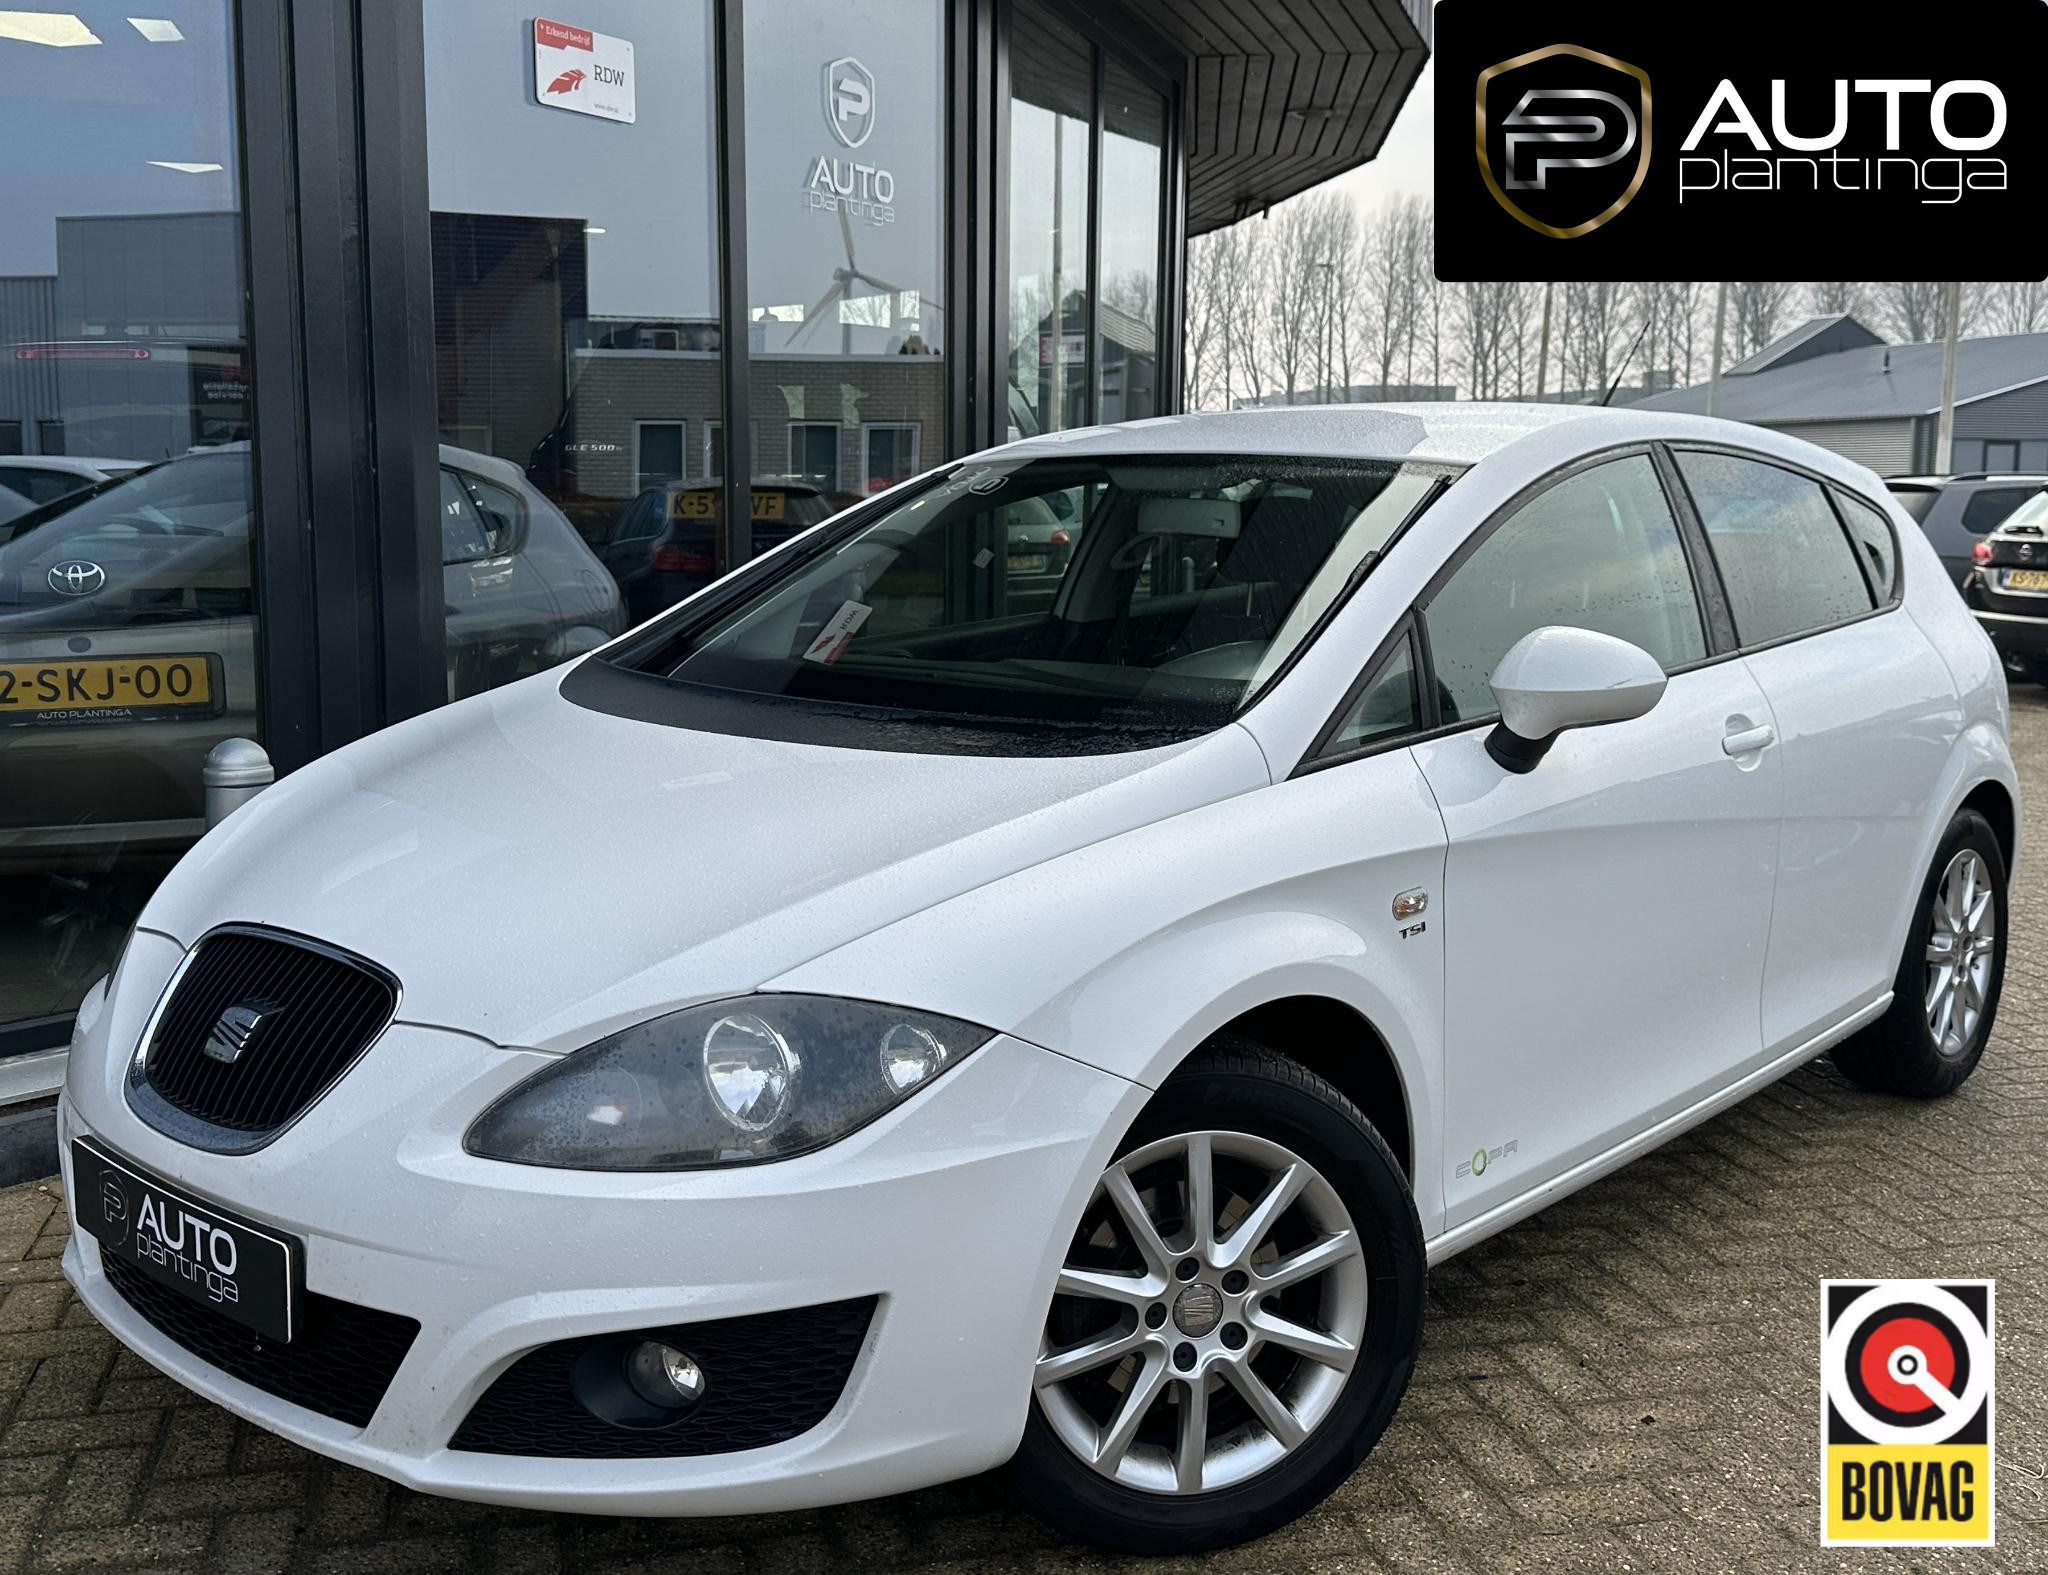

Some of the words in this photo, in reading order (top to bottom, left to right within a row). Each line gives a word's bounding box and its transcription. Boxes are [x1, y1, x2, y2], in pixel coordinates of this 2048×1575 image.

[545, 25, 569, 41] Erkend
[593, 64, 625, 87] RDW
[811, 155, 894, 203] AUTO
[809, 190, 895, 226] plantinga
[565, 444, 589, 452] GLE
[591, 444, 616, 452] 500
[0, 663, 192, 704] 2-SKJ-00
[36, 711, 67, 720] AUTO
[69, 708, 133, 719] PLANTINGA
[1398, 921, 1426, 940] TSI
[136, 1193, 237, 1276] AUTO
[136, 1230, 239, 1303] plantinga
